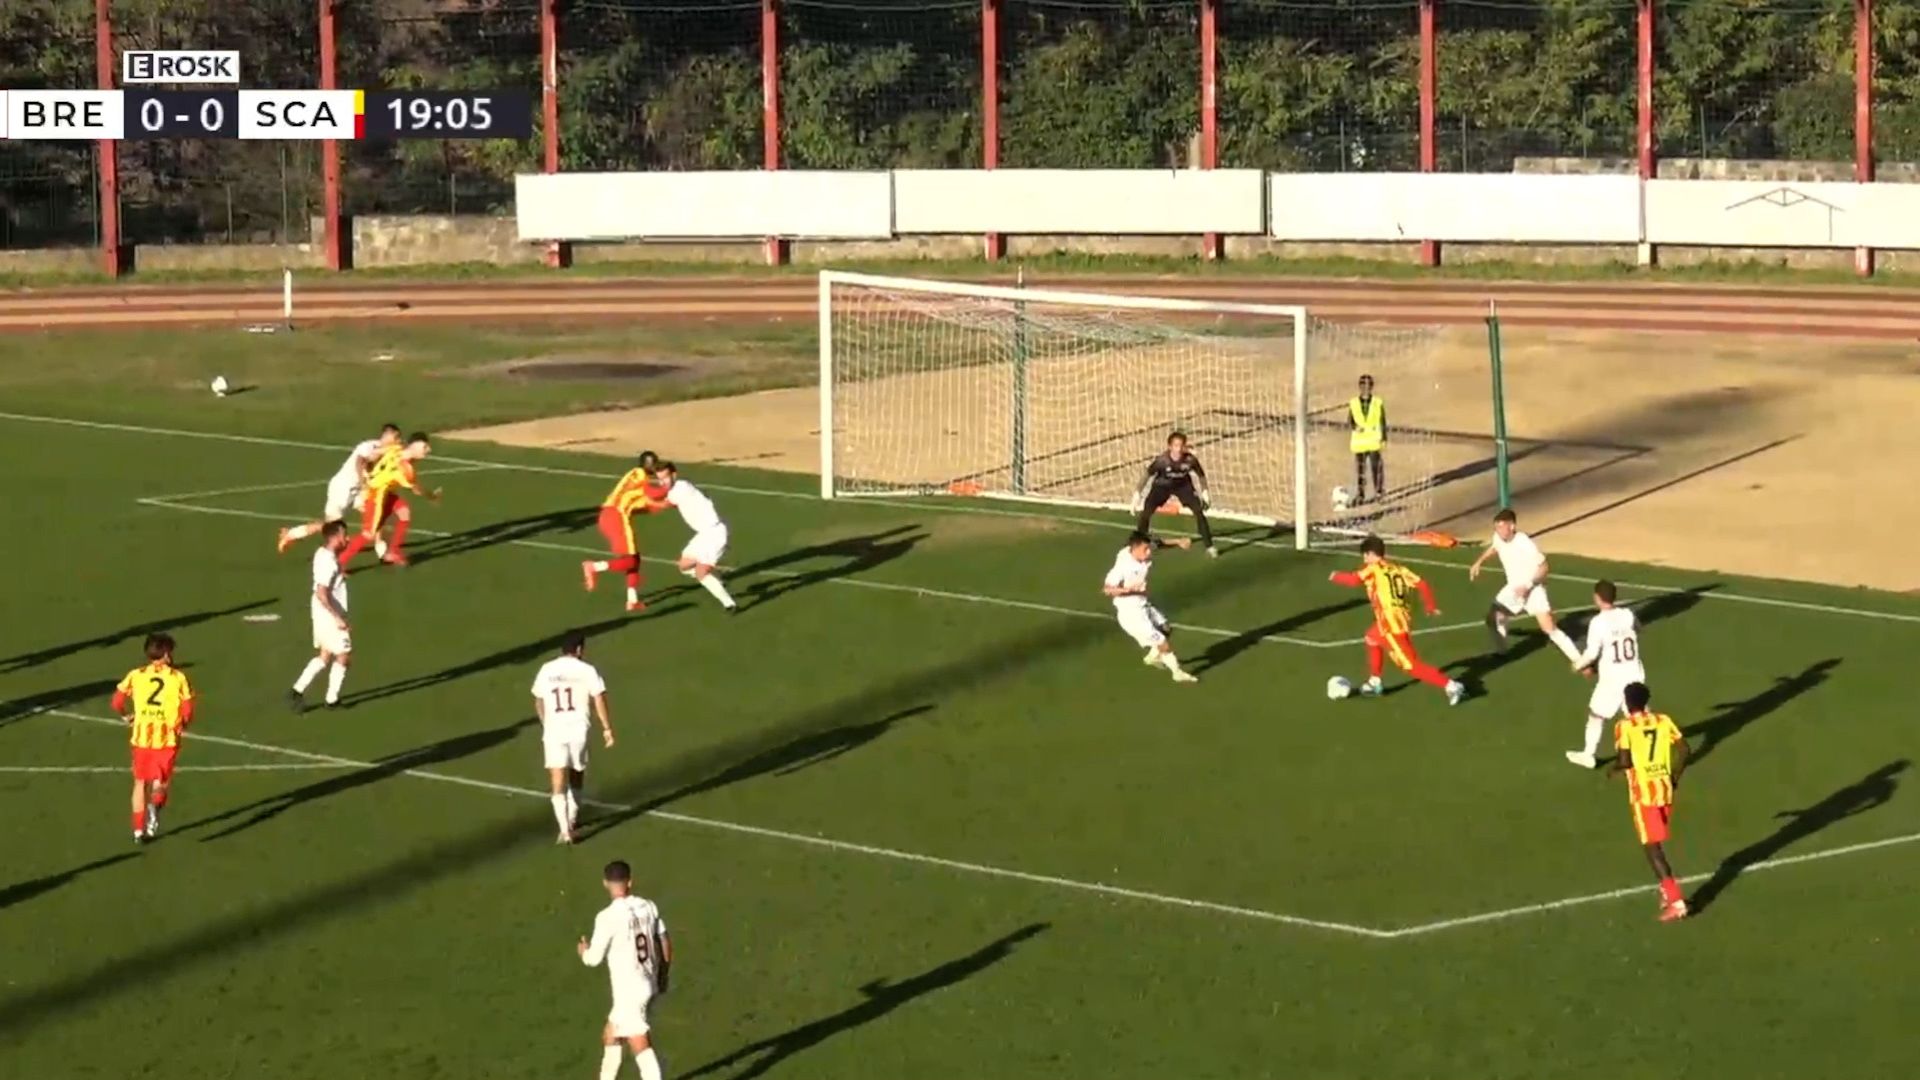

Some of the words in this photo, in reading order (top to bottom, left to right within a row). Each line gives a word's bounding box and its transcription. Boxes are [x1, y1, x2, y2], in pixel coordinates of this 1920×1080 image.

[1384, 572, 1407, 600] 10
[1612, 636, 1636, 664] 10
[147, 677, 165, 706] 2
[551, 687, 576, 713] 11
[1643, 729, 1658, 762] 7
[635, 933, 650, 964] 9
